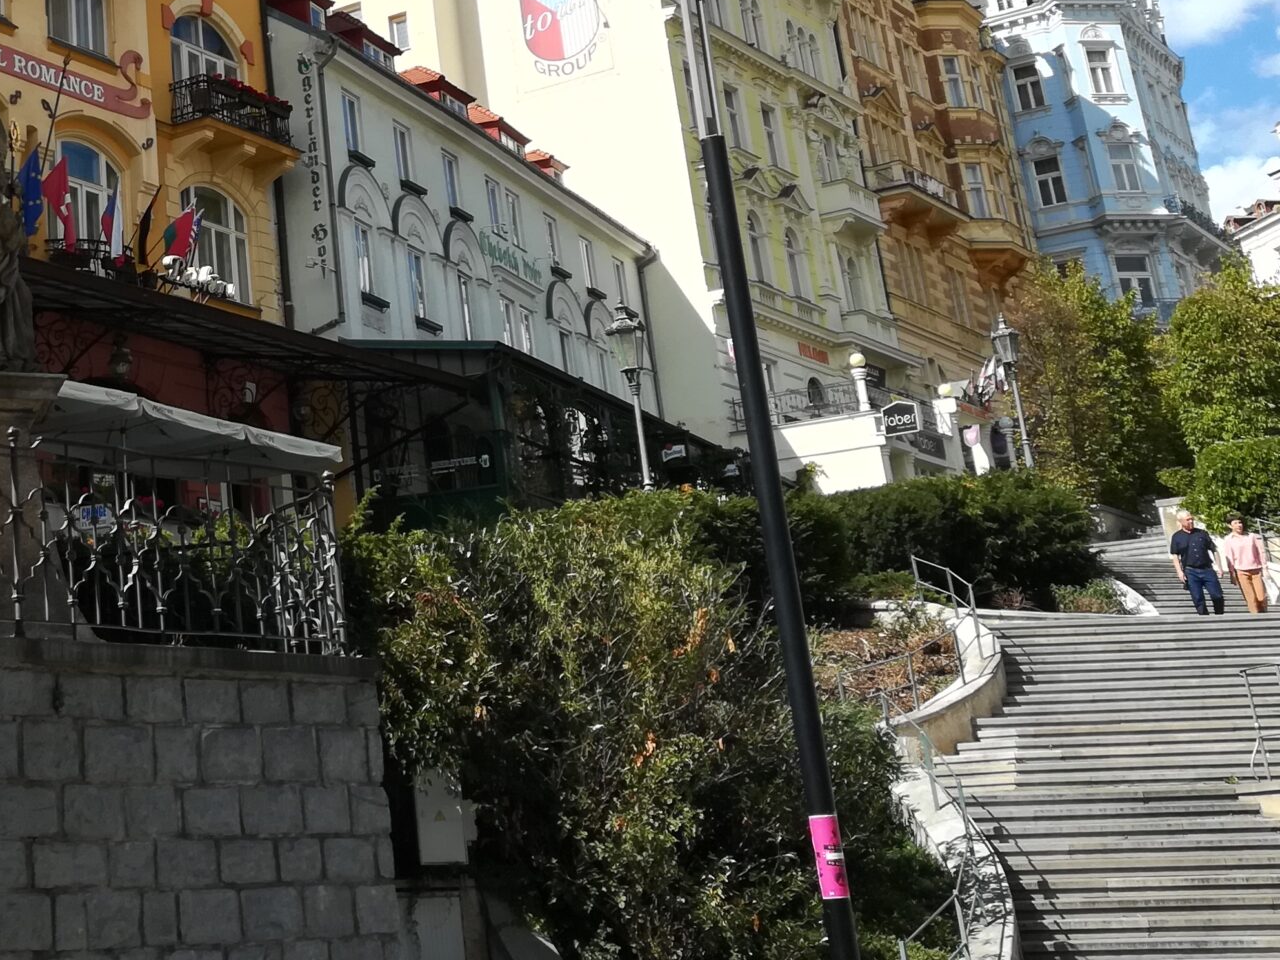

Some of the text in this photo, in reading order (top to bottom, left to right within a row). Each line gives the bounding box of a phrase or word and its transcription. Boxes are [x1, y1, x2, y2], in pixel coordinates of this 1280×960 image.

[534, 42, 597, 77] GROUP
[13, 54, 105, 103] ROMANCE
[885, 413, 916, 427] faber
